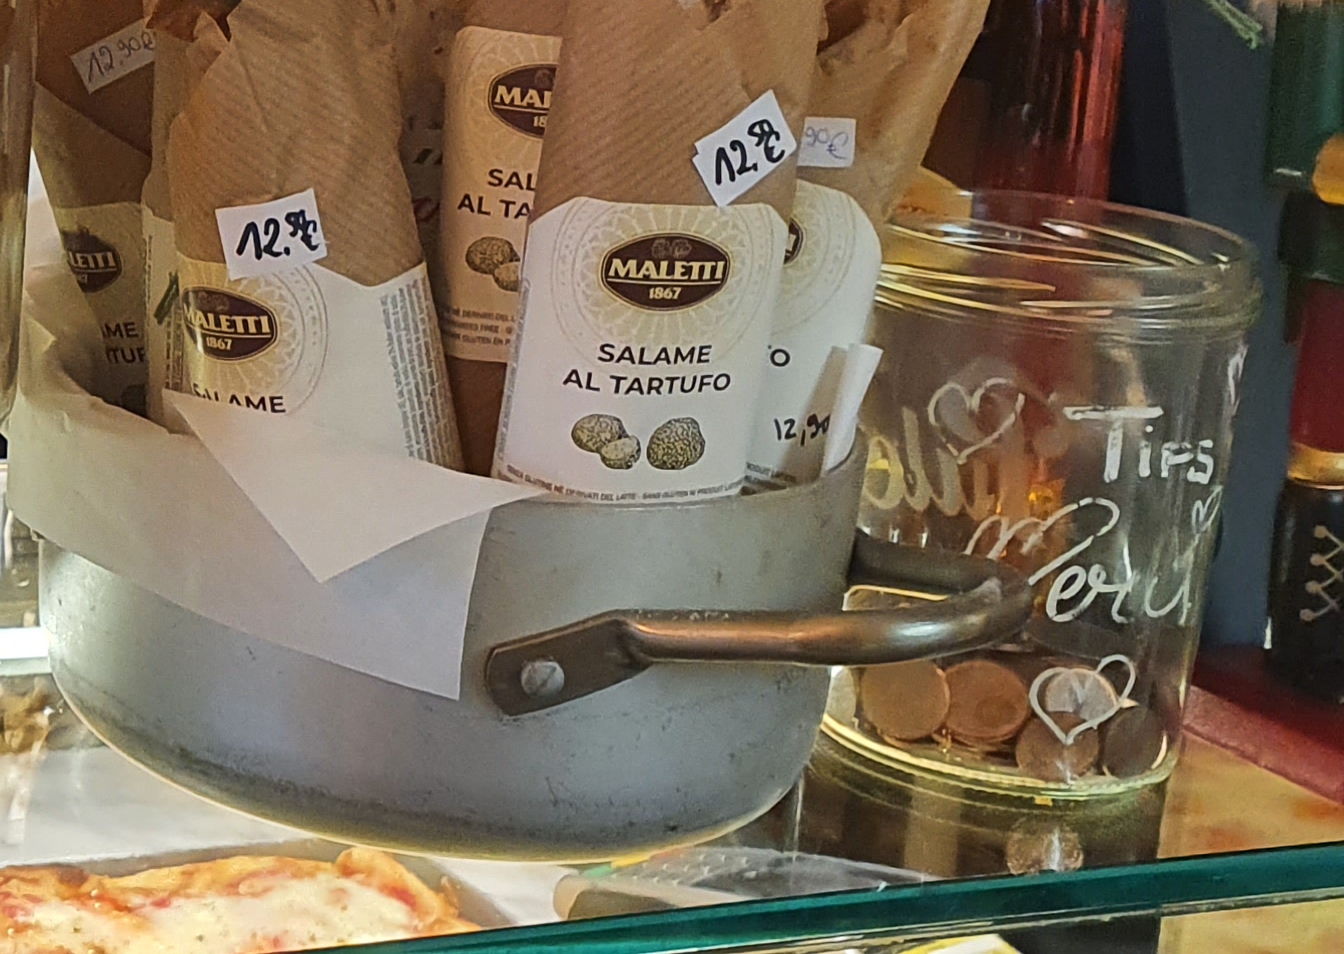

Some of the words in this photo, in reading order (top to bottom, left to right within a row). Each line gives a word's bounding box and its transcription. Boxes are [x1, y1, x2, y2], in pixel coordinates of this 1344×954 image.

[487, 168, 536, 192] SAL
[457, 193, 491, 216] AL
[68, 251, 117, 268] LETTI
[608, 258, 727, 282] MALETTI
[648, 286, 683, 300] 1867
[184, 303, 272, 334] MALETTI
[206, 336, 233, 351] 1867
[597, 343, 713, 366] SALAME
[562, 369, 601, 392] AL
[609, 373, 732, 396] TARTUFO
[192, 382, 287, 414] SAME
